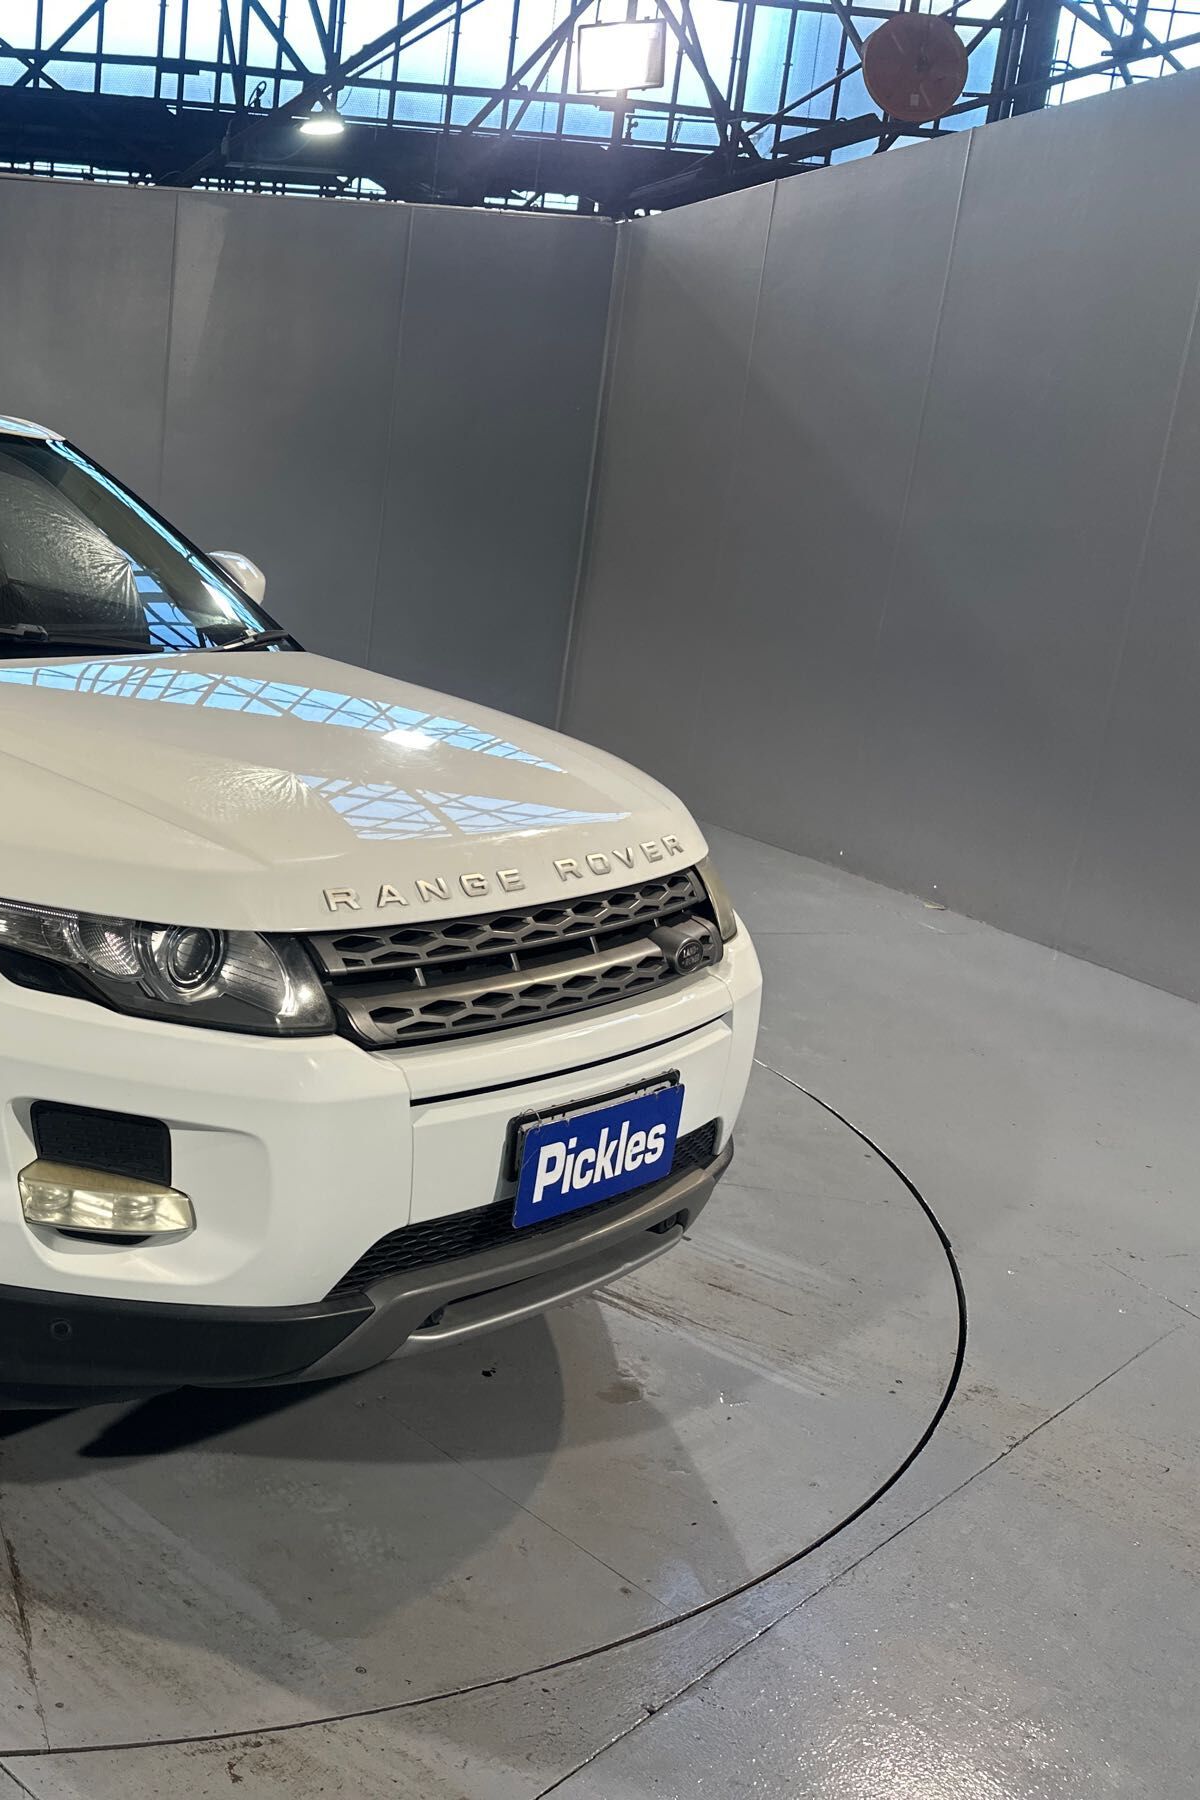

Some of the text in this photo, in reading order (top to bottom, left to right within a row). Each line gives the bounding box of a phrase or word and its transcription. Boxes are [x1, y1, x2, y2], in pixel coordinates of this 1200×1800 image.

[322, 834, 685, 912] RANGE ROVER
[532, 1120, 667, 1204] Pickles
